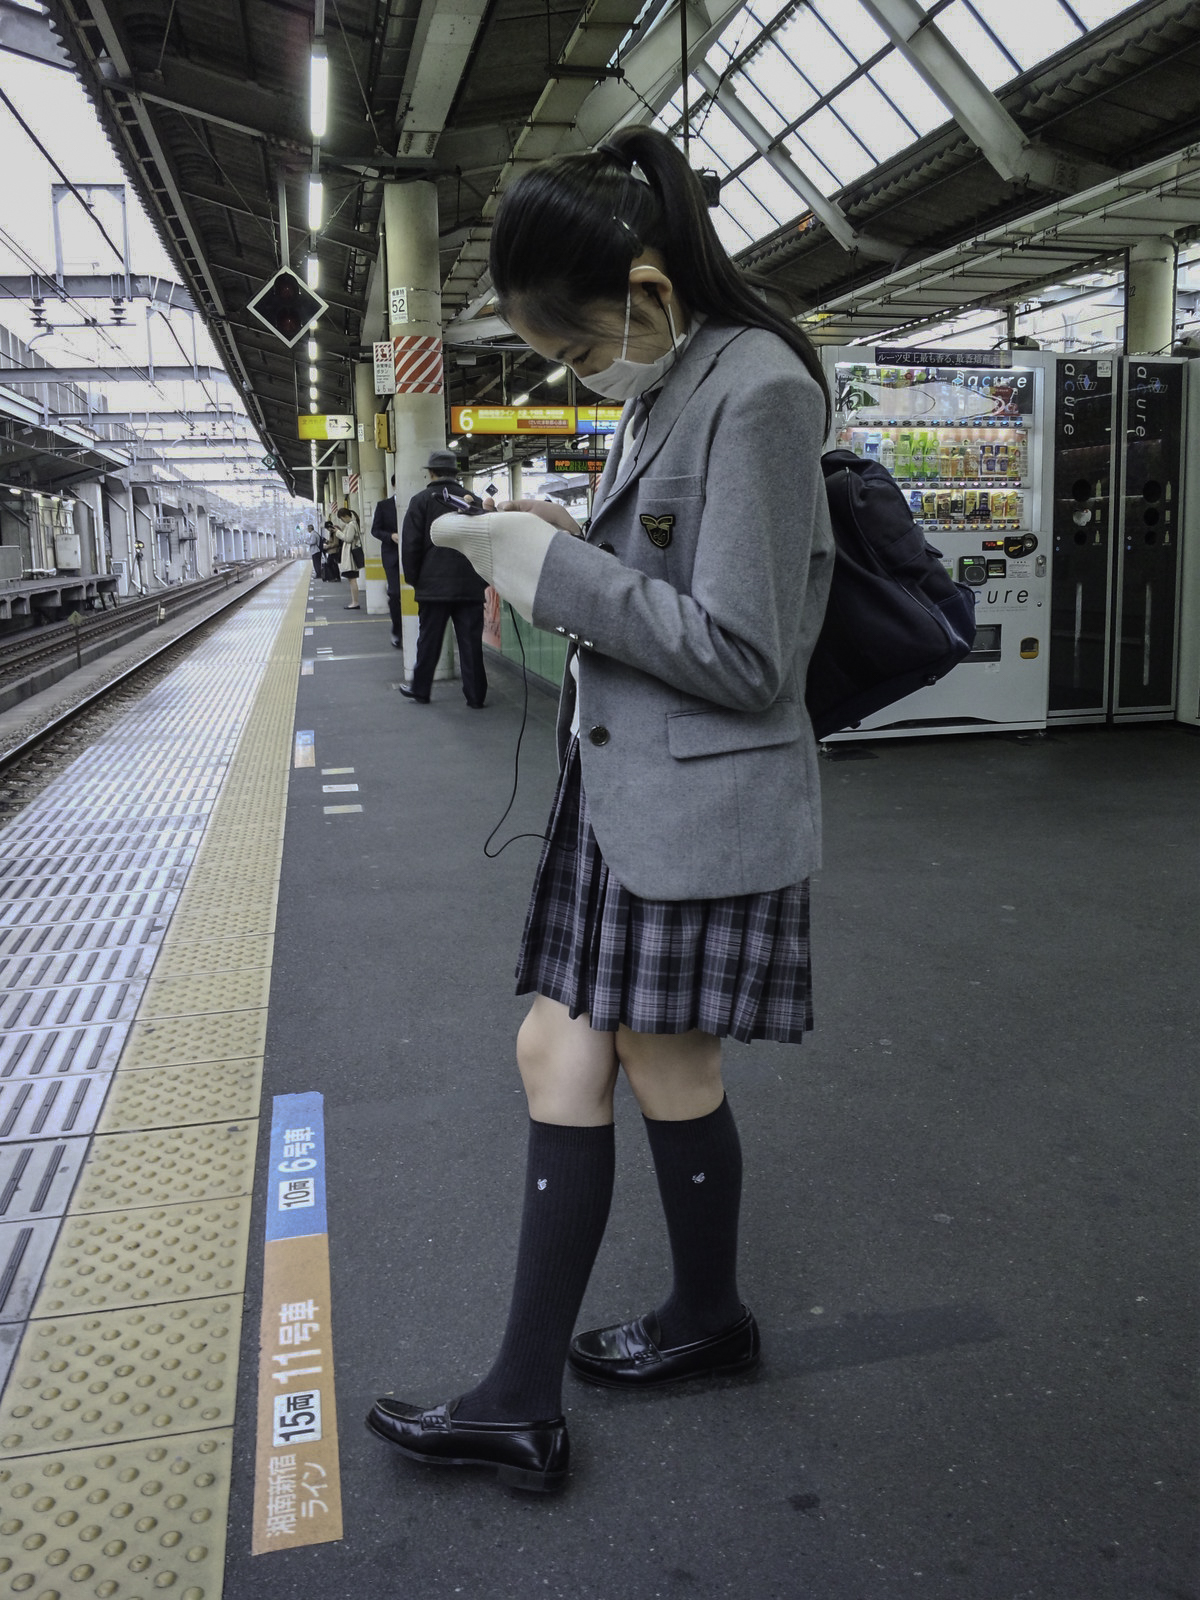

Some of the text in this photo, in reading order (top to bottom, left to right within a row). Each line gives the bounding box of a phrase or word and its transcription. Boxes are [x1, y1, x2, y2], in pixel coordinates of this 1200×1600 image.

[392, 299, 405, 313] 52
[459, 409, 474, 431] 6
[1064, 363, 1075, 435] acure
[1136, 366, 1147, 437] acure
[974, 590, 1029, 605] cure
[277, 1126, 317, 1207] 10両 6号車
[271, 1299, 323, 1442] 15両 11号車
[265, 1453, 297, 1538] 湘南新宿
[301, 1462, 329, 1518] ライン
